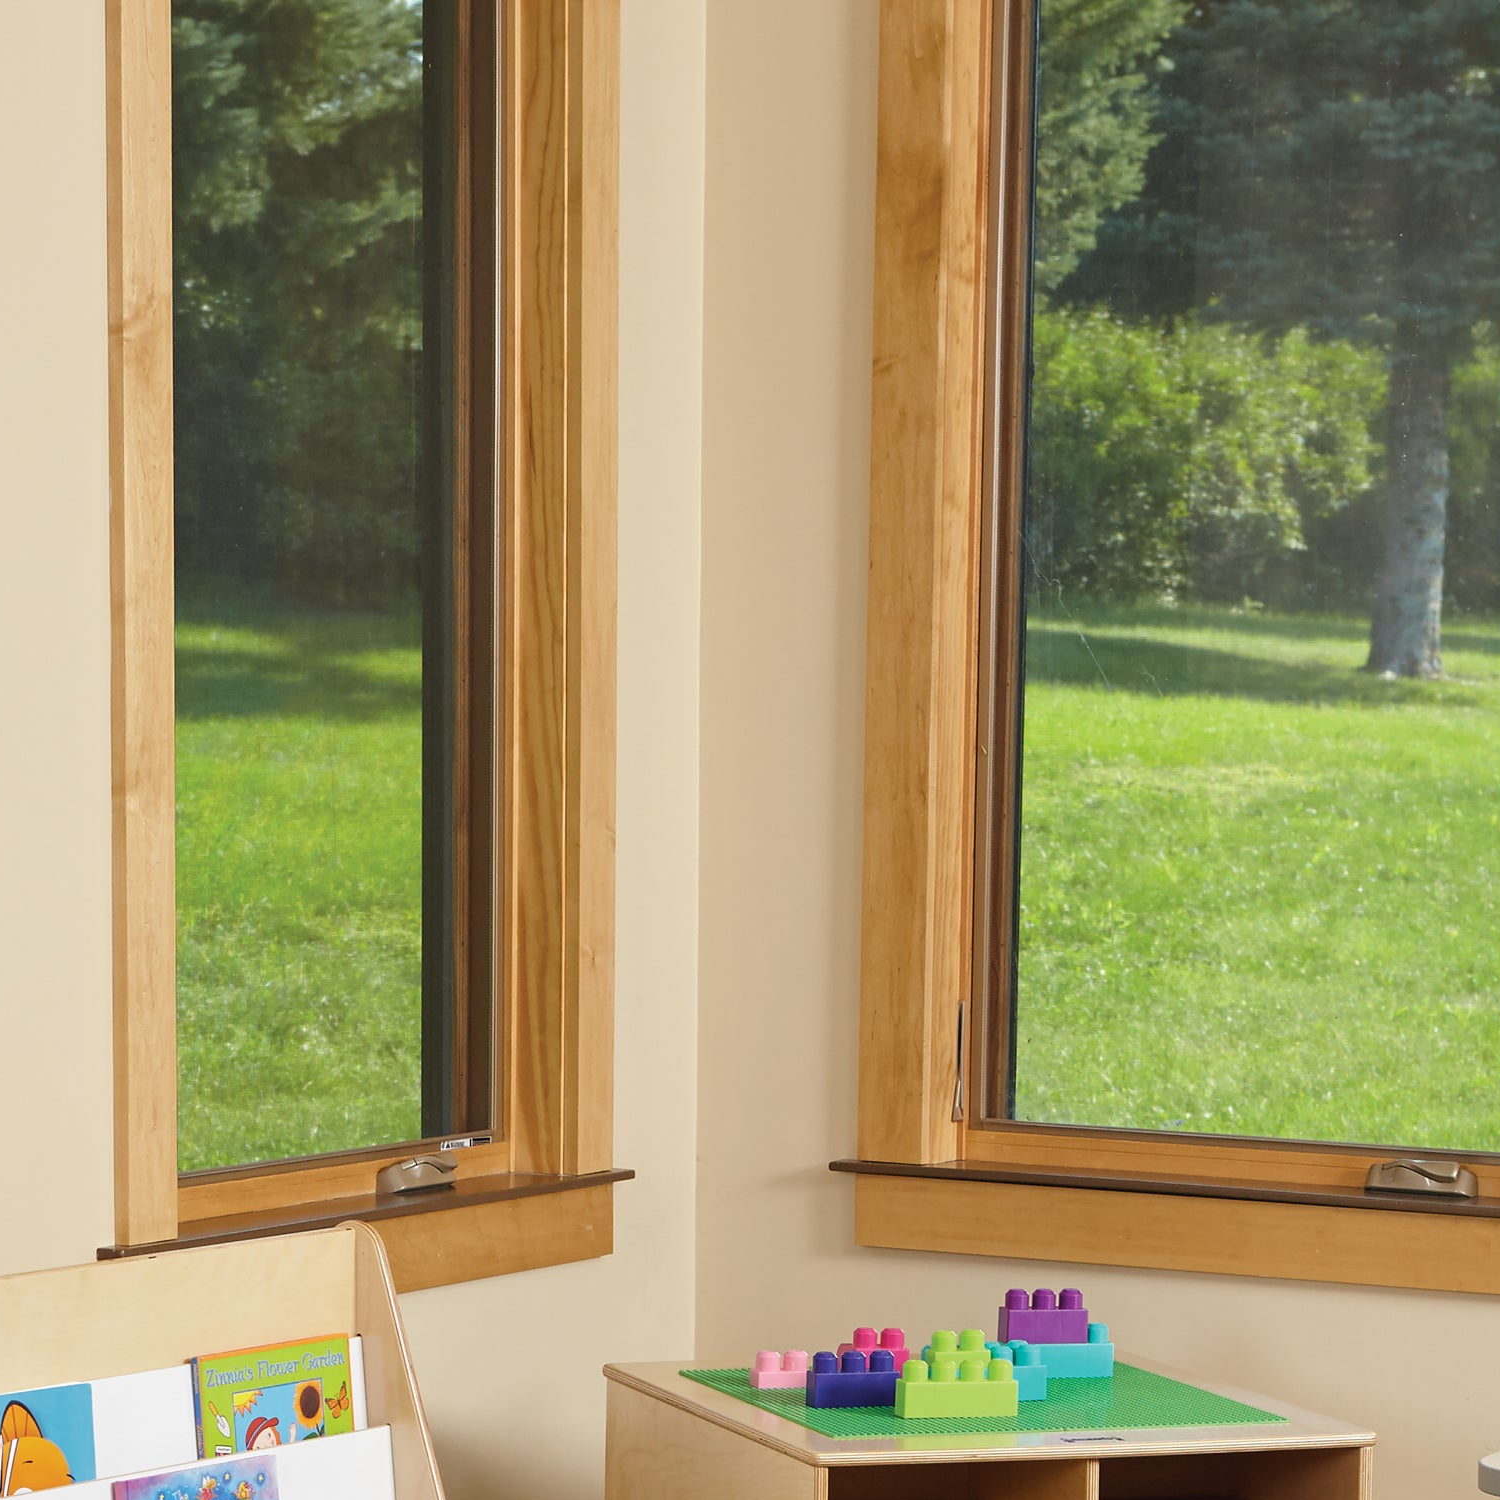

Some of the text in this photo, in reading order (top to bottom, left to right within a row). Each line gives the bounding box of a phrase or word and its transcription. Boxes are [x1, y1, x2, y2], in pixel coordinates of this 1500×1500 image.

[206, 1366, 254, 1388] Zinnia's
[257, 1360, 299, 1379] Flower
[302, 1350, 345, 1370] Garden
